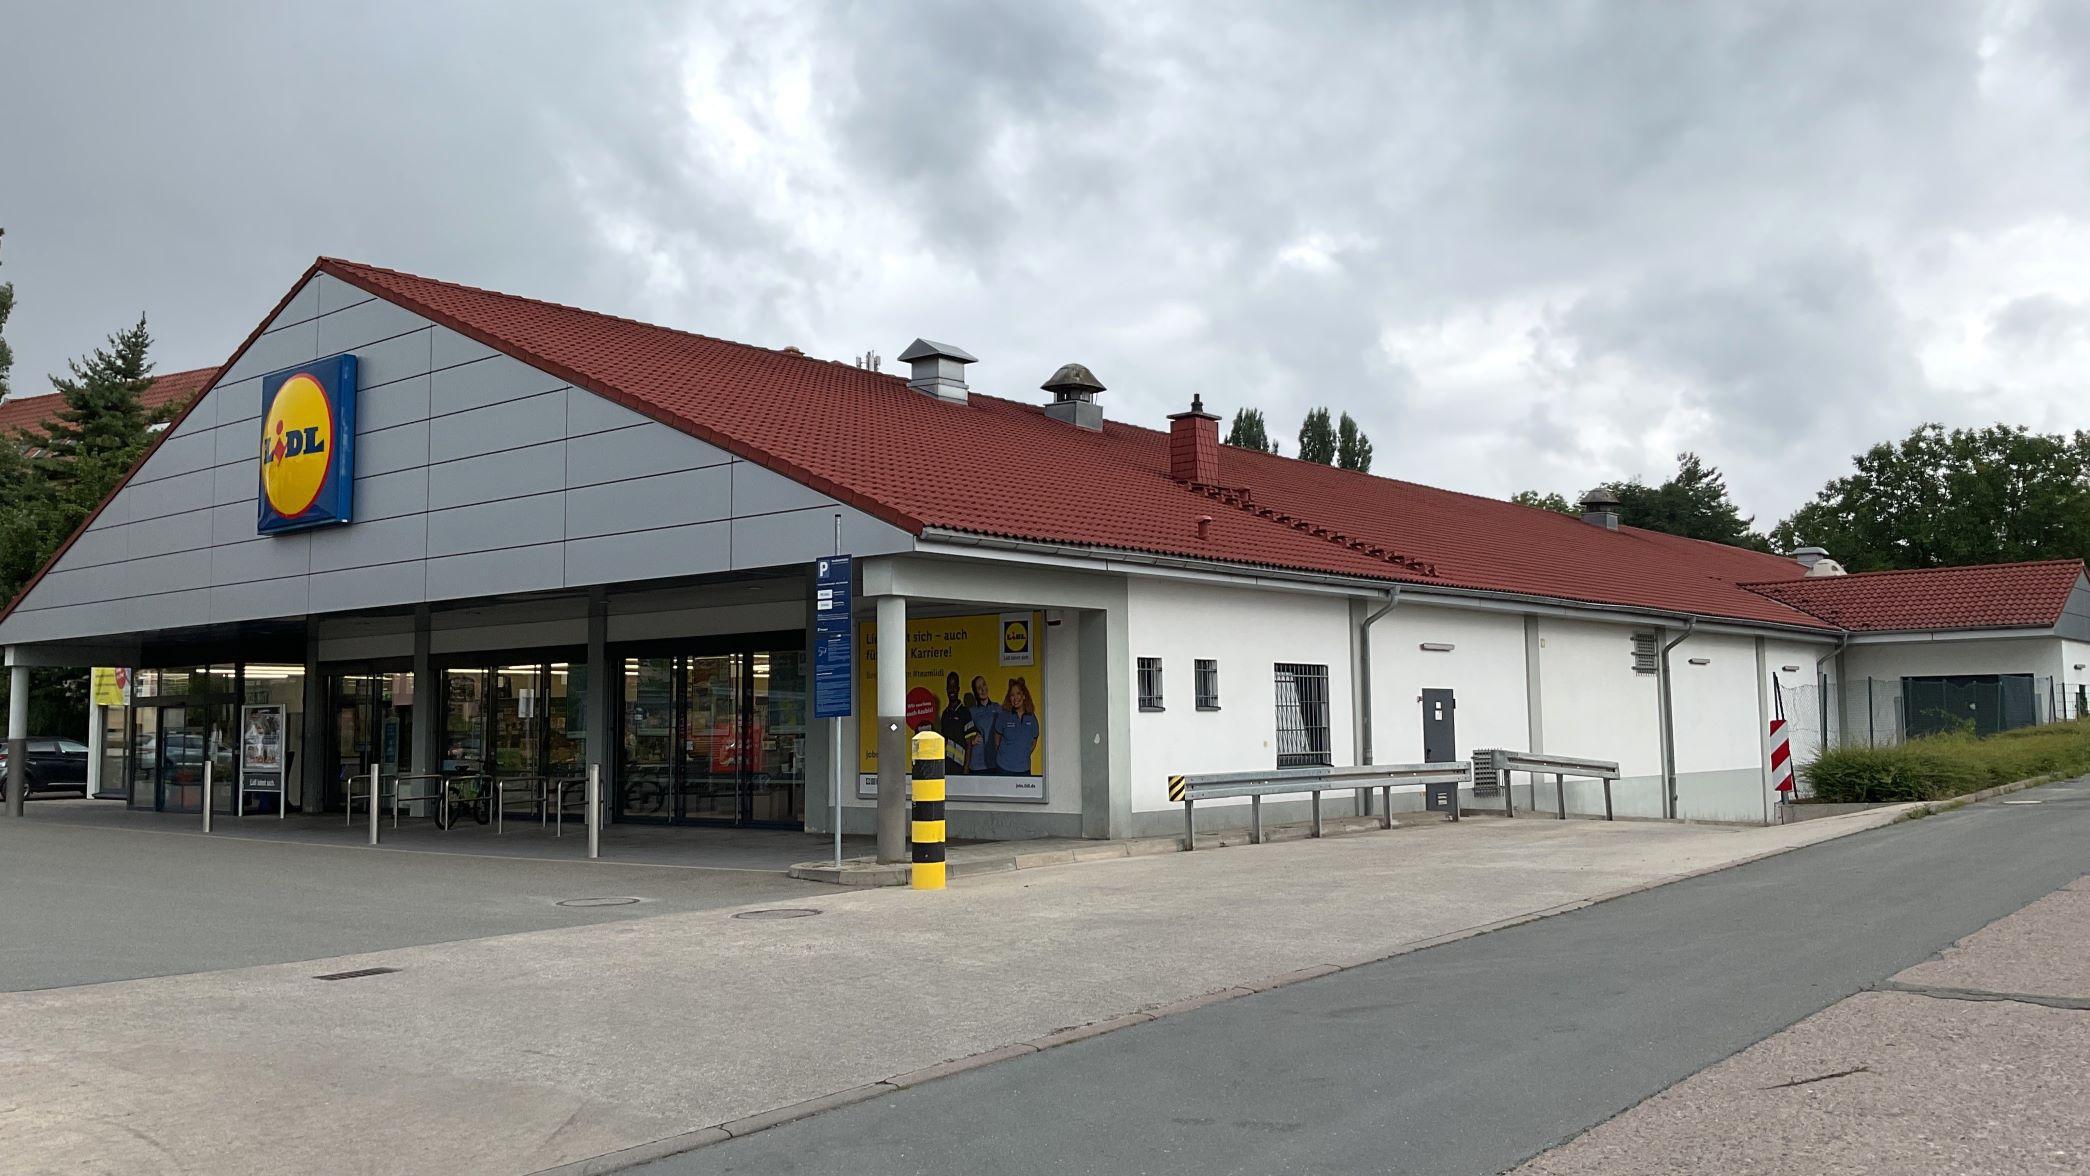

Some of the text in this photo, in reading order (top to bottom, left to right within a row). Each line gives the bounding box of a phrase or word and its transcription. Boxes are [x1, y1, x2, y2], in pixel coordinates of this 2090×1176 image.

[819, 561, 829, 577] P
[913, 630, 932, 643] sich
[943, 628, 968, 641] auch
[866, 646, 952, 661] fü Karriere!
